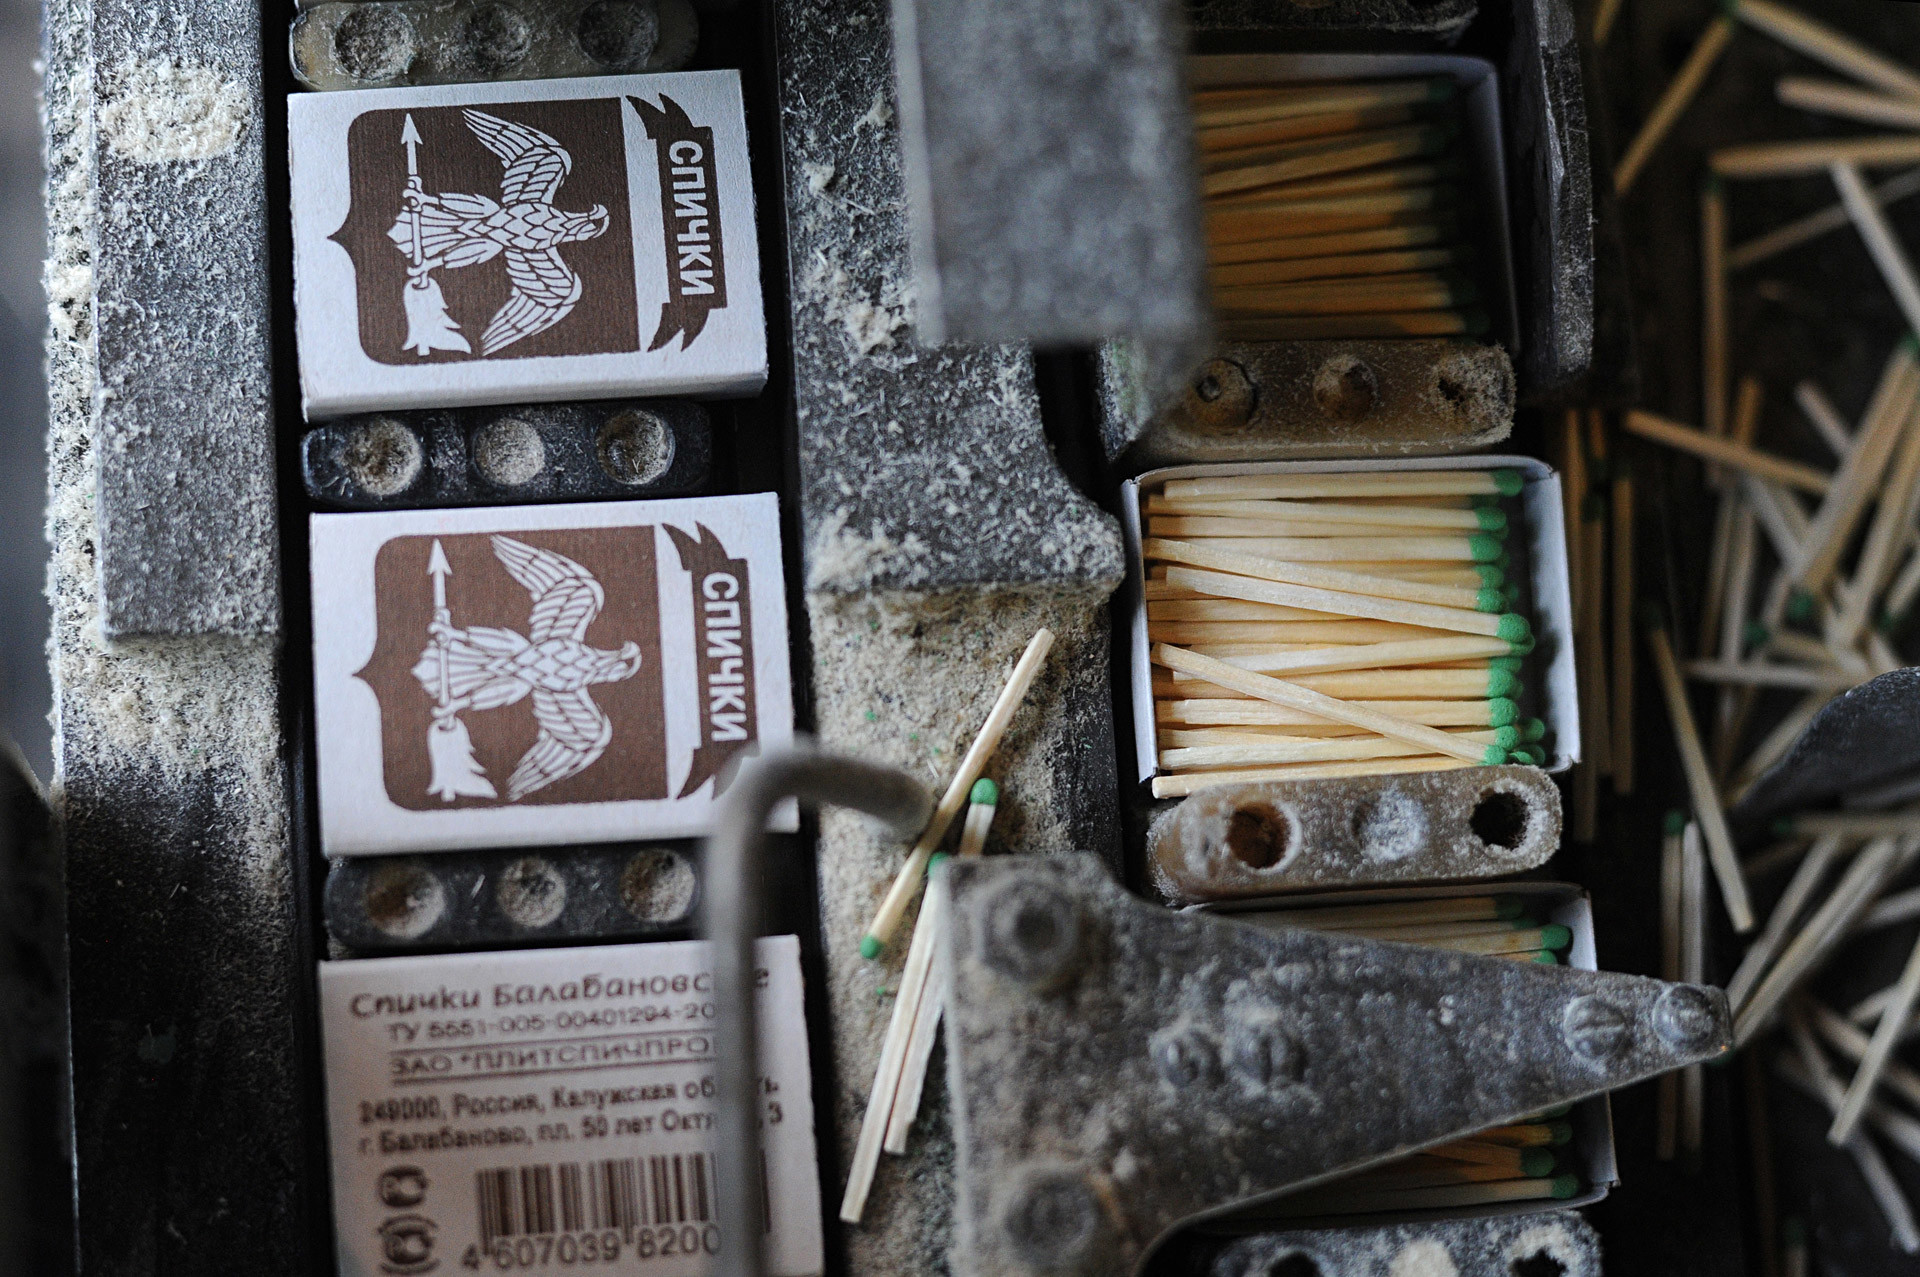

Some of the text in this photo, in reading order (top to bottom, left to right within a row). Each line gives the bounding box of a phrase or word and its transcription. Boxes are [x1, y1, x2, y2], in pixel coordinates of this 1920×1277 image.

[669, 140, 715, 296] СПИЧКИ
[702, 571, 748, 742] СПИЧКИ
[350, 968, 770, 1020] Спички Балабановсе
[388, 1021, 421, 1042] ТУ
[392, 1054, 452, 1077] ЗАО
[453, 1092, 546, 1117] Россия,
[552, 1085, 677, 1110] Калужская
[615, 1115, 655, 1136] лет
